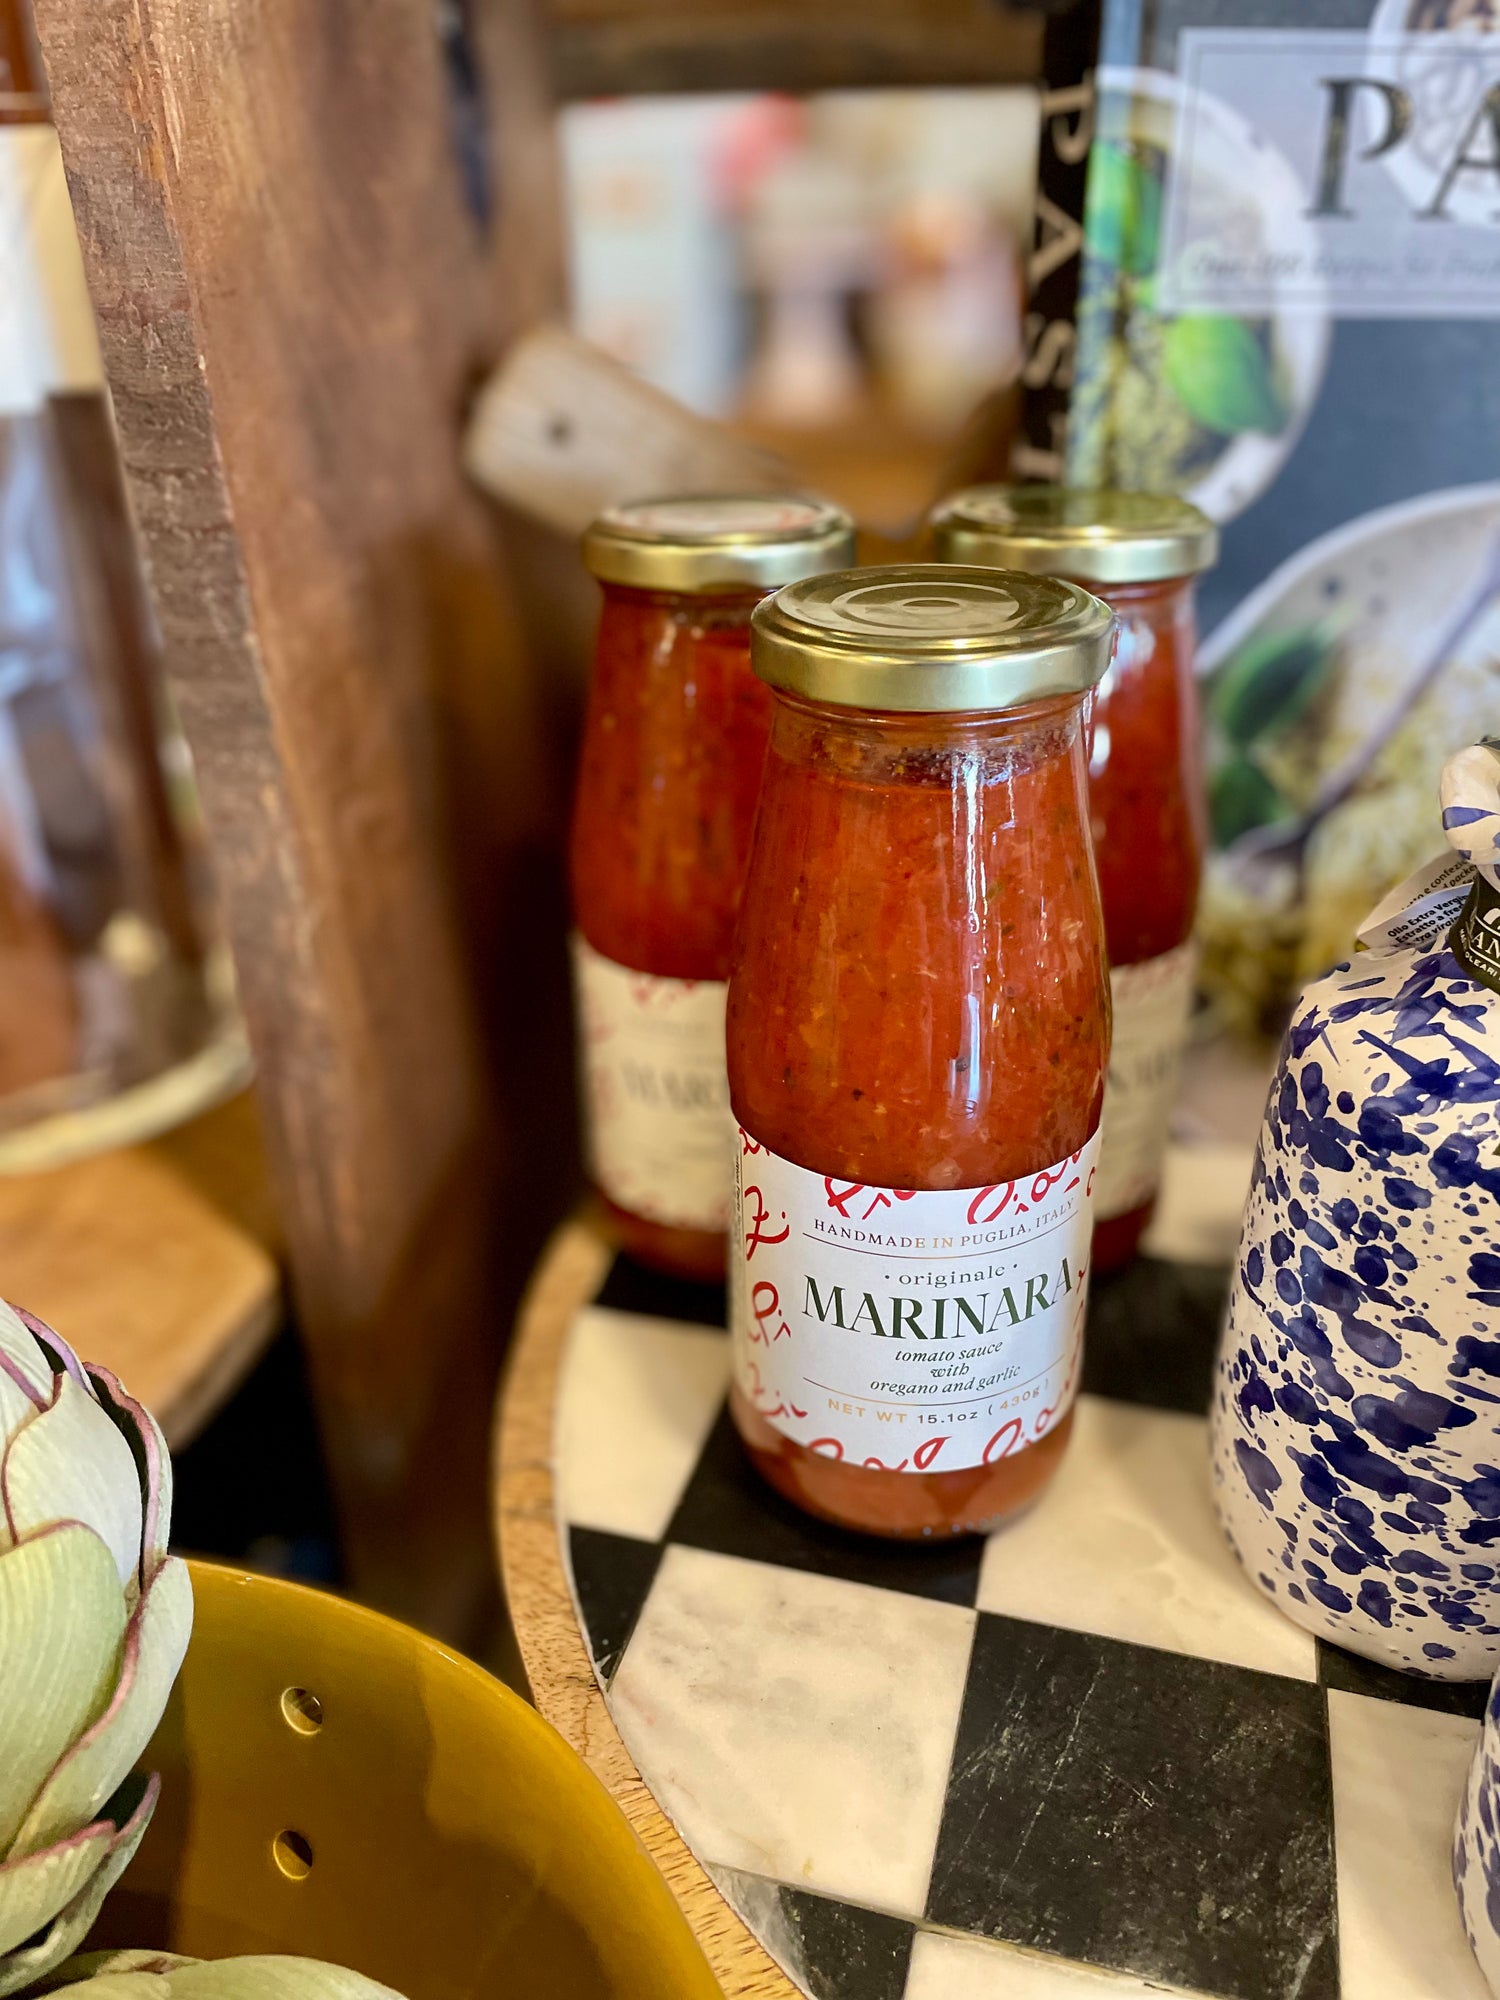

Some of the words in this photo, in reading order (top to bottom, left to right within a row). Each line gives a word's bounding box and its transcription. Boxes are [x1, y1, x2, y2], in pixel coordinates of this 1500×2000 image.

[1407, 909, 1437, 926] Extra
[1436, 914, 1445, 922] a
[1464, 951, 1498, 977] OLEARI
[814, 1218, 926, 1249] HANDMADE
[931, 1236, 954, 1249] IN
[960, 1223, 1032, 1247] PUGLIA,
[1035, 1196, 1075, 1229] ITALY
[802, 1256, 1073, 1340] MARINARA
[895, 1350, 955, 1362] tomato
[958, 1341, 1004, 1360] sauce
[869, 1380, 939, 1396] oregano
[941, 1376, 976, 1393] and
[975, 1364, 1021, 1392] garlic
[929, 1362, 970, 1378] with
[828, 1397, 867, 1418] NET
[876, 1410, 908, 1424] WT
[917, 1410, 978, 1425] 15.1oz
